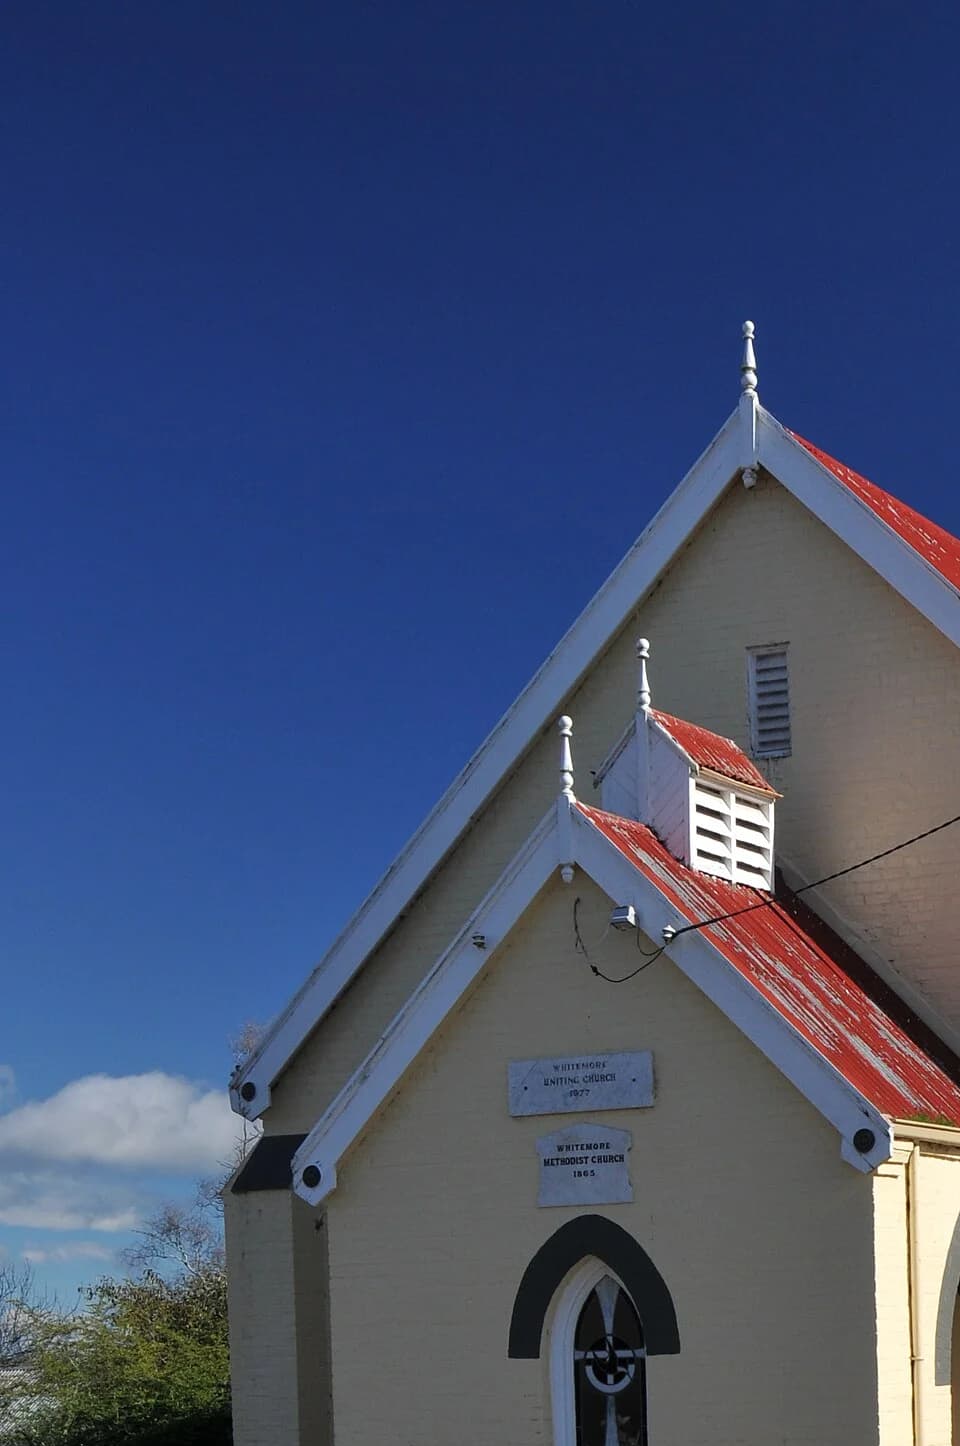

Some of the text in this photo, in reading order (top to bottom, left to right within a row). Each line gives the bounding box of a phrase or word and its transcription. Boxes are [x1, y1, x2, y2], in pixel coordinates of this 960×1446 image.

[553, 1062, 607, 1072] WHITEMORE
[543, 1073, 616, 1086] UNITING CHURCH
[557, 1142, 610, 1152] WHITEMORE
[543, 1154, 625, 1167] METHODIST CHURCH
[573, 1169, 595, 1178] 1865
